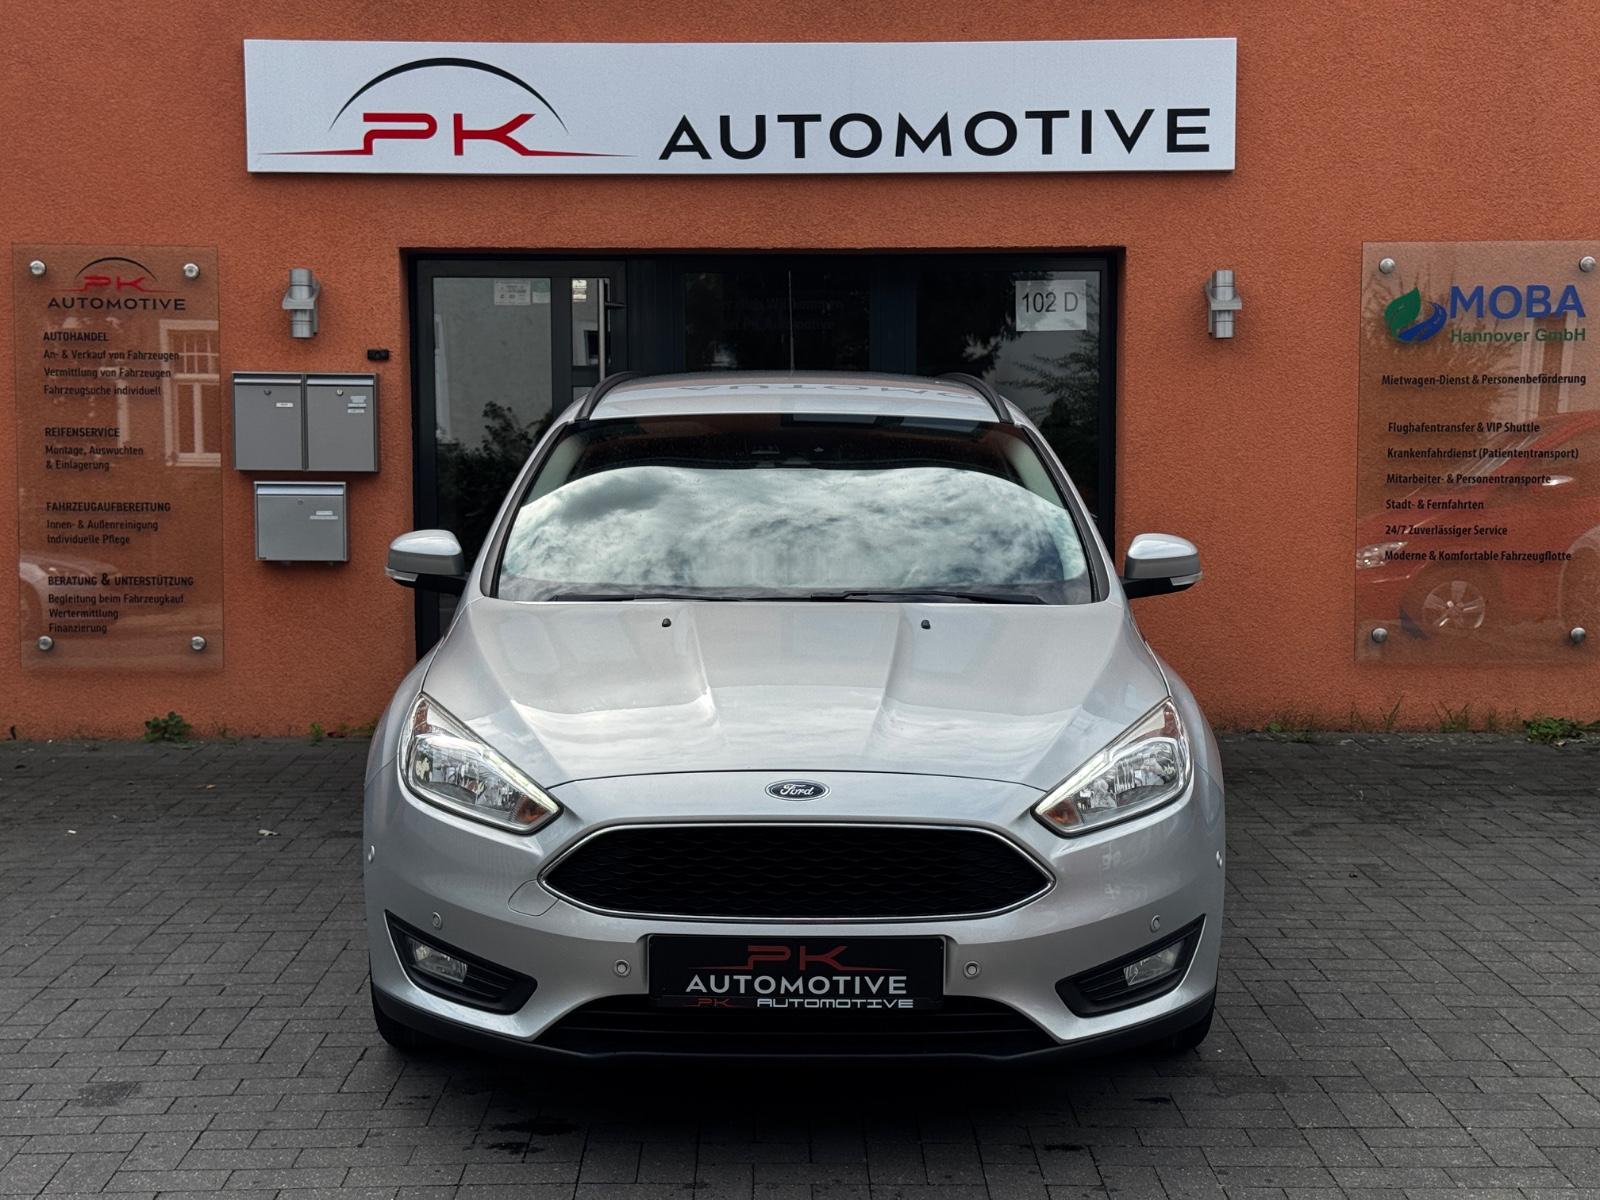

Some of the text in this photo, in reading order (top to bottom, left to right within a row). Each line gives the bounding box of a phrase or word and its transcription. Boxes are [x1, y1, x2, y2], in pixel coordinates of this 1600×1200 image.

[363, 107, 1210, 160] PK AUTOMOTIVE
[83, 275, 145, 291] PK
[47, 297, 186, 311] AUTOMOTIVE
[1021, 291, 1079, 313] 102 D
[1450, 284, 1586, 319] MOBA
[43, 331, 109, 341] AUTOHANDEL
[1450, 327, 1586, 343] Hannover GmbH
[43, 350, 179, 361] An- & Verkauf von Fahrzeugen
[43, 368, 171, 379] Vermittlung von Fahrzeugen
[1381, 373, 1587, 387] Mietwagen-Dienst & Personenbeförderung
[43, 386, 162, 397] Fahrzeugsuche individuell
[44, 427, 120, 438] REIFENSERVICE
[1388, 422, 1541, 435] Flughafentransfer & VIP Shuttle
[45, 446, 144, 457] Montage, Auswuchten
[1386, 448, 1579, 461] Krankenfahrdienst (Patiententransport)
[46, 461, 110, 472] & Einlagerung
[1386, 474, 1552, 486] Mitarbeiter- & Personentransporte
[46, 502, 171, 513] FAHRZEUGAUFBEREITUNG
[1385, 499, 1485, 510] Stadt- & Fernfahrten
[46, 520, 159, 532] Innen- & Außenreinigung
[1384, 524, 1508, 537] 24/7 Zuverlässiger Service
[47, 535, 130, 546] Individuelle Pflege
[1384, 551, 1572, 563] Moderne & Komfortable Fahrzeugflotte
[48, 573, 194, 586] BERATUNG & UNTERSTÜTZUNG
[48, 593, 184, 606] Begleitung beim Fahrzeugkauf
[49, 608, 119, 620] Wertermittlung
[48, 623, 107, 635] Finanzierung
[780, 783, 815, 796] Ford
[747, 944, 848, 971] PK
[685, 973, 908, 995] AUTOMOTIVE
[756, 998, 914, 1009] AUTOMOTIVE
